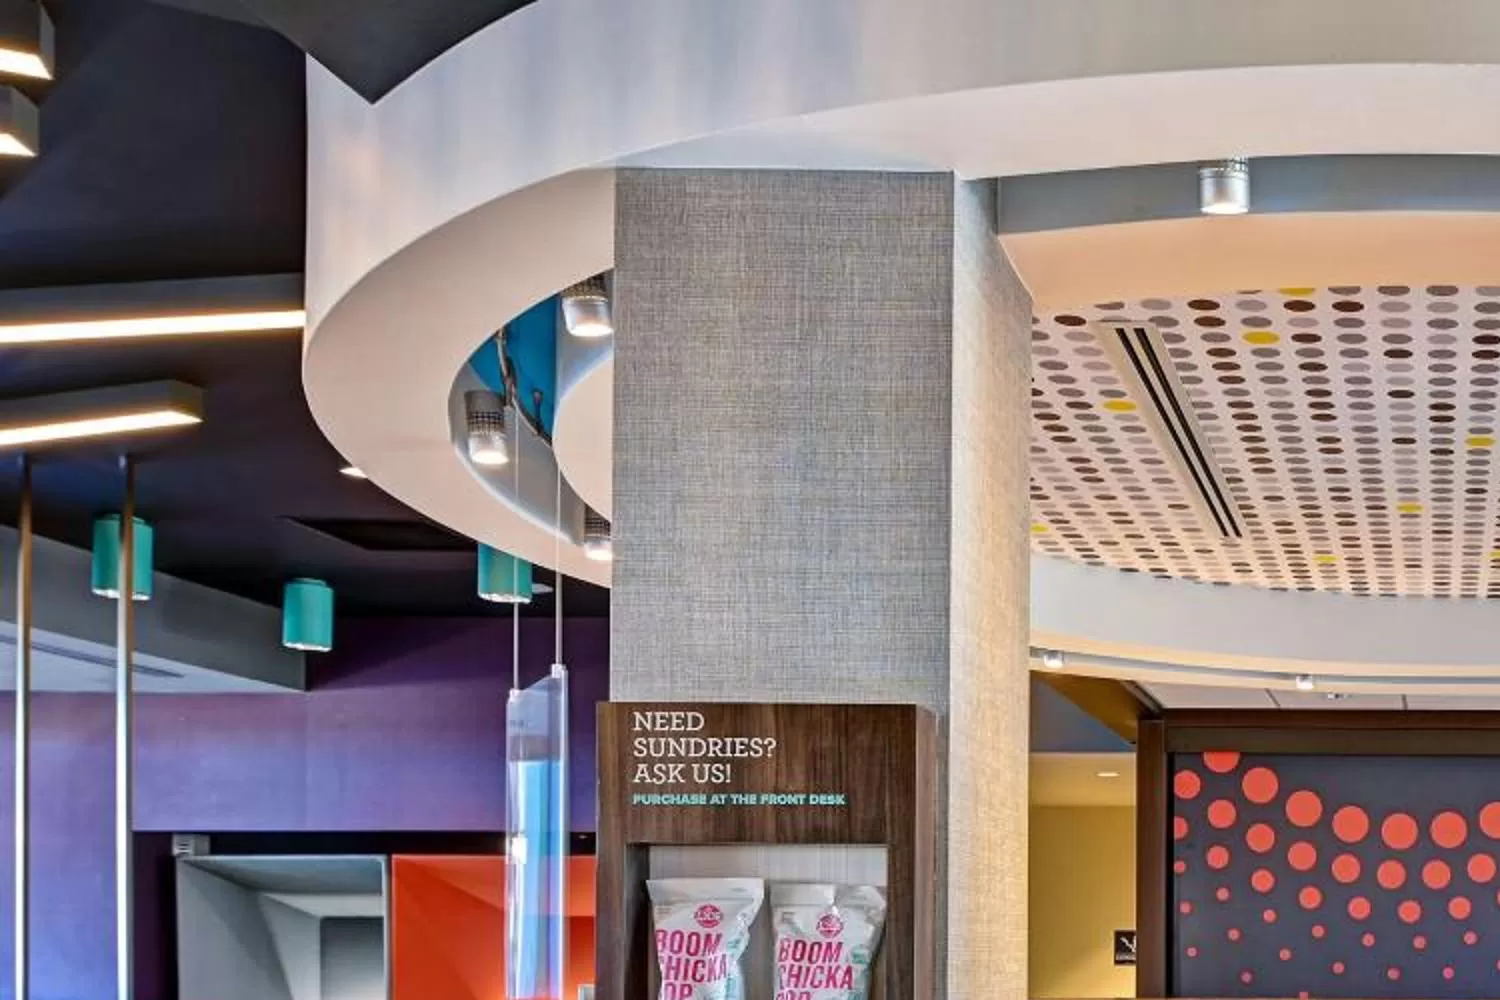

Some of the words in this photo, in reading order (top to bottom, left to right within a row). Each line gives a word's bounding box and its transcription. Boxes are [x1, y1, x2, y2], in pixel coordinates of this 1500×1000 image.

[633, 711, 705, 732] NEED
[633, 737, 777, 758] SUNDRIES?
[633, 763, 686, 785] ASK
[692, 763, 732, 784] US!
[633, 793, 707, 805] PURCHASE
[710, 793, 727, 805] AT
[730, 793, 757, 805] THE
[760, 793, 806, 805] FRONT
[809, 793, 846, 805] DESK
[656, 929, 724, 958] BOOM
[778, 937, 844, 964] BOOM
[658, 953, 728, 983] HICKA
